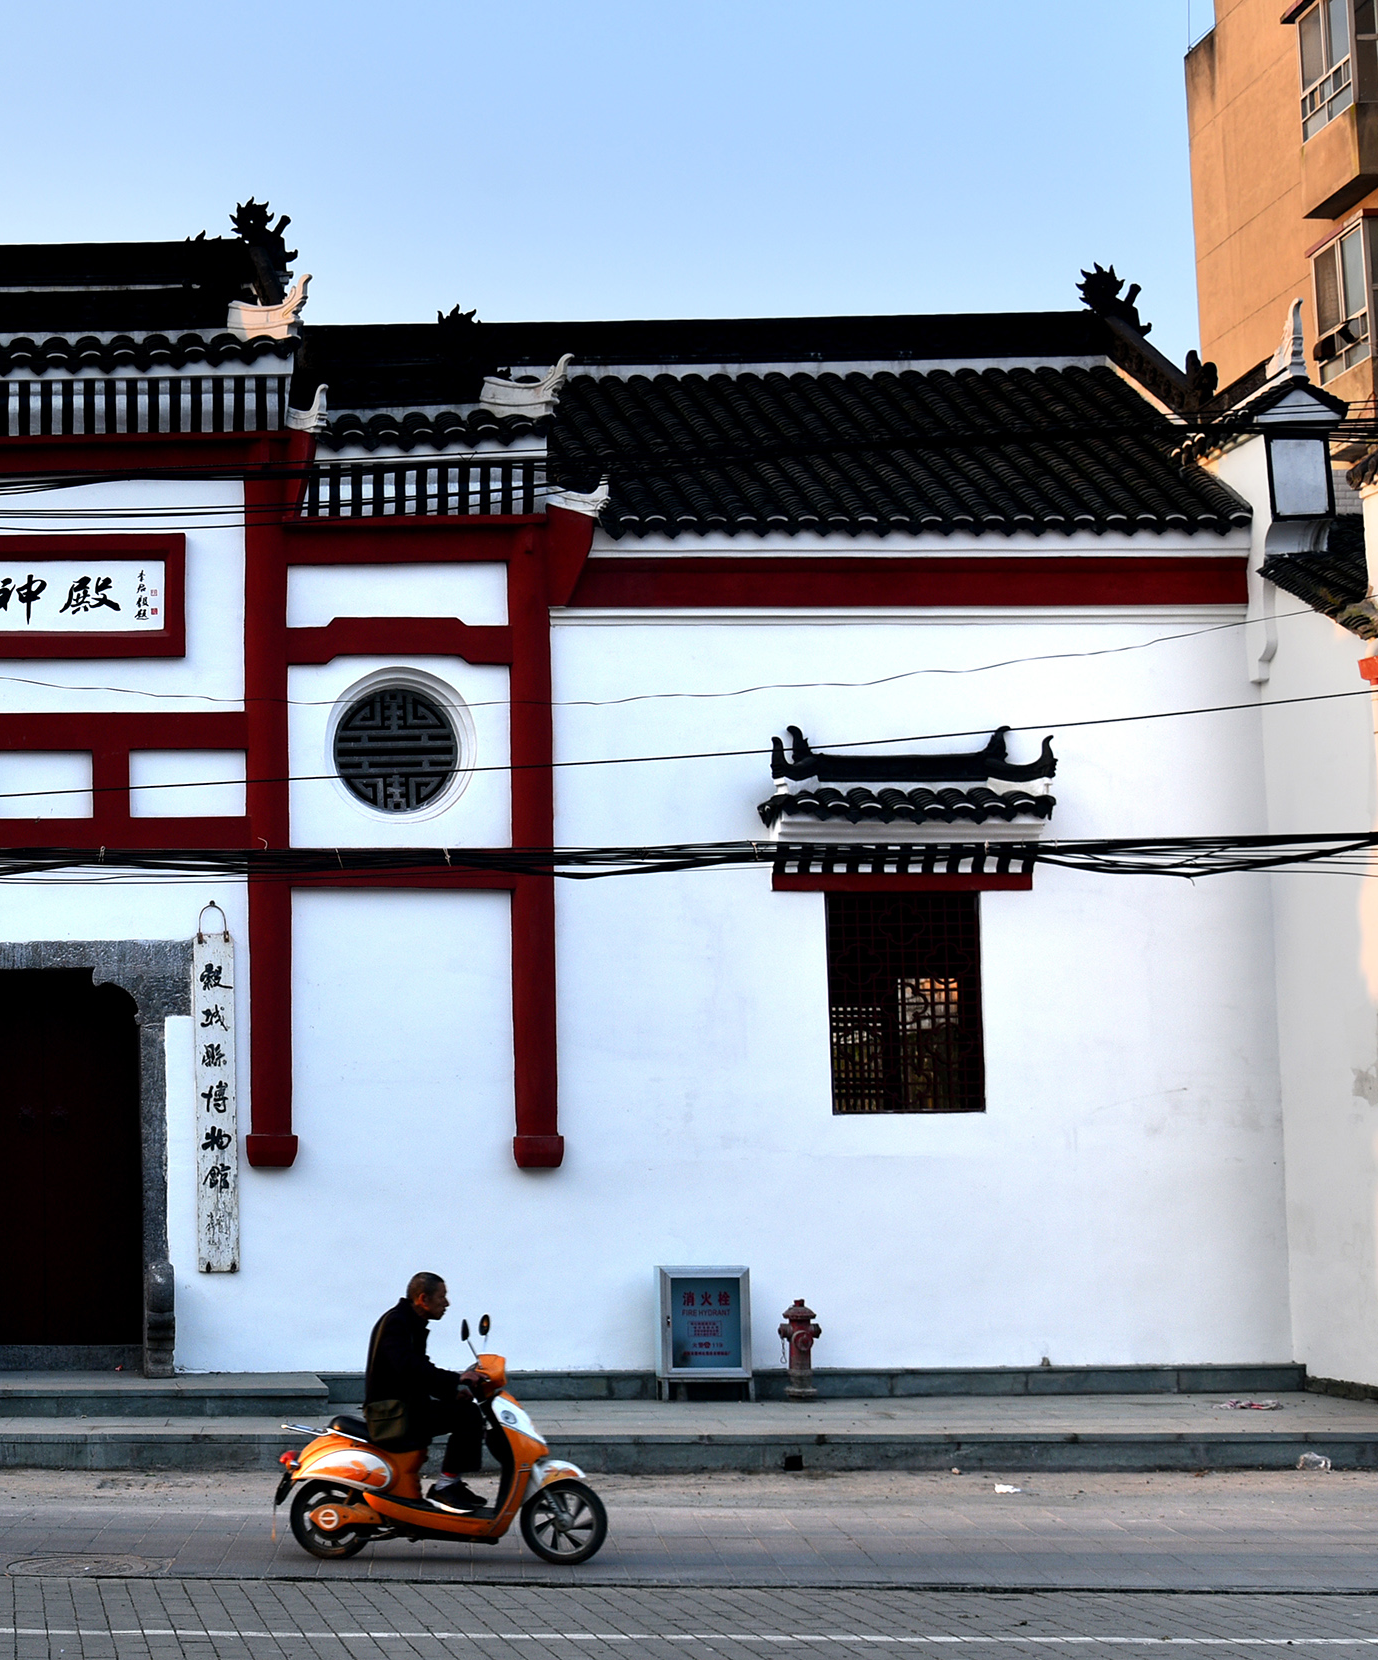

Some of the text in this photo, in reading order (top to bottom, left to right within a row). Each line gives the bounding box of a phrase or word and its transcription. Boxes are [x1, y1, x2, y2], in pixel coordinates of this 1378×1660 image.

[682, 1291, 731, 1307] 消火栓
[681, 1308, 731, 1317] FIRE HYDRANT
